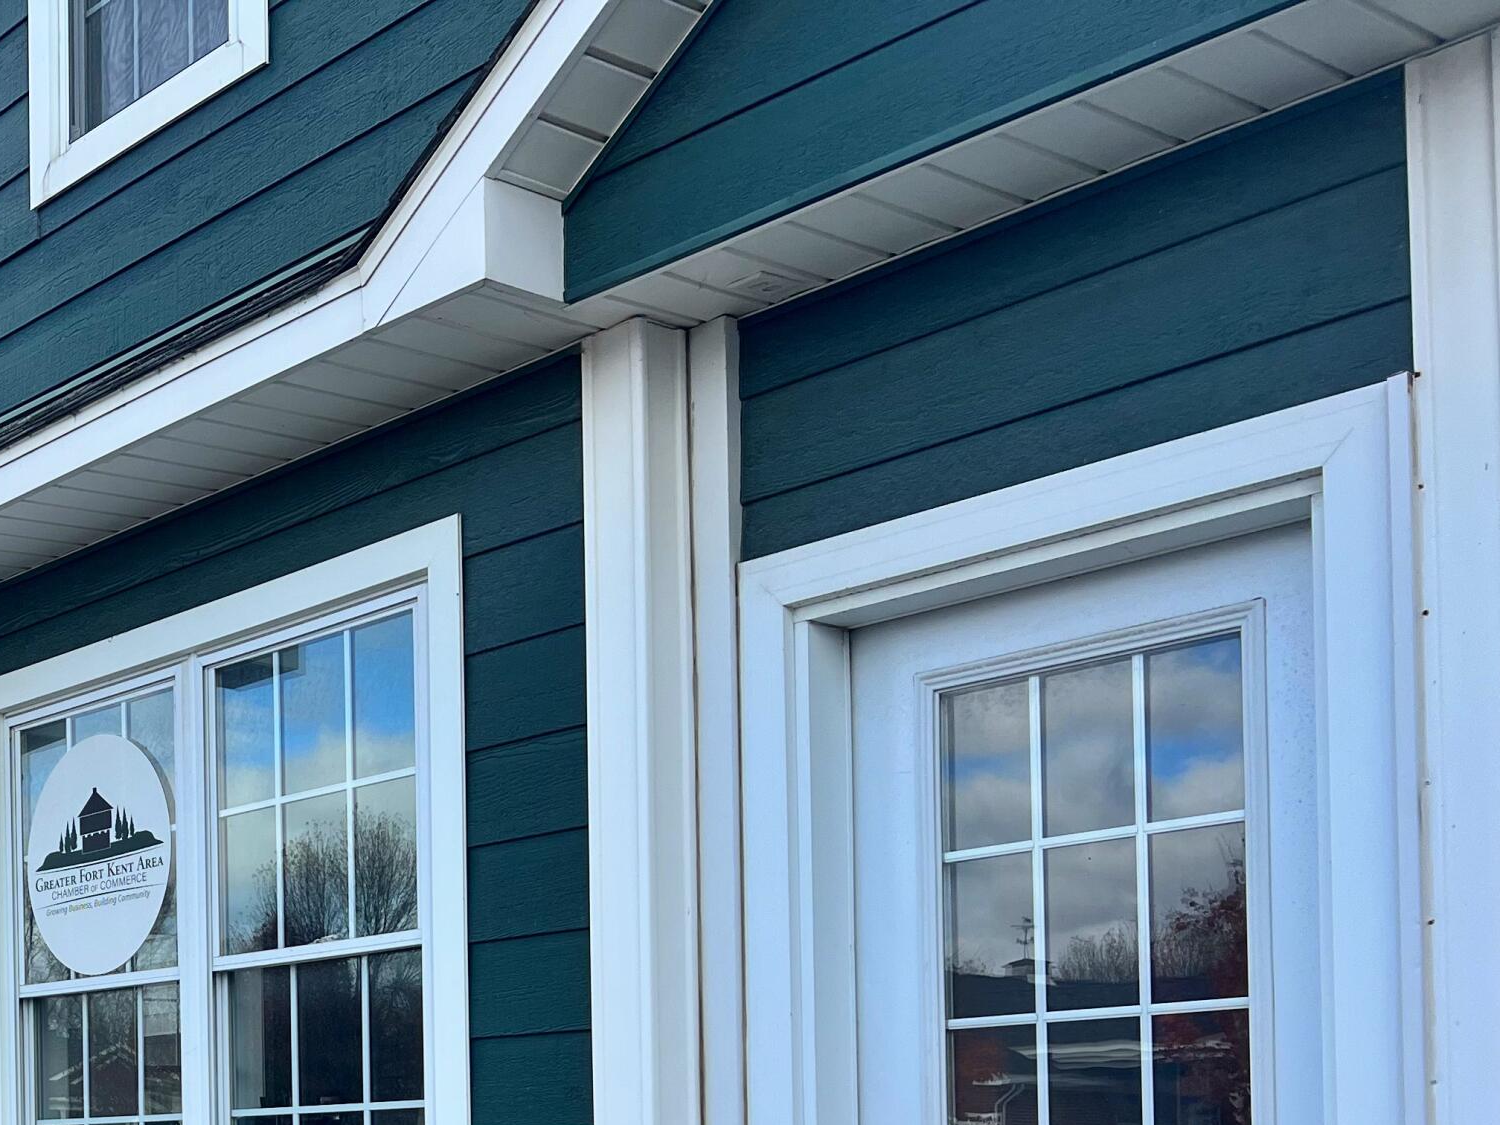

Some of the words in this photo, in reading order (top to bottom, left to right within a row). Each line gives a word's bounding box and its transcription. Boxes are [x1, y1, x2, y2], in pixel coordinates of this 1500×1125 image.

[35, 875, 77, 893] GREATER
[80, 868, 104, 883] FORT
[107, 862, 134, 877] KENT
[136, 855, 164, 870] AREA
[51, 884, 89, 900] CHAMBER
[100, 872, 147, 890] COMMERCE
[46, 905, 68, 917] Growing
[94, 896, 117, 907] Building
[117, 890, 151, 904] Community
